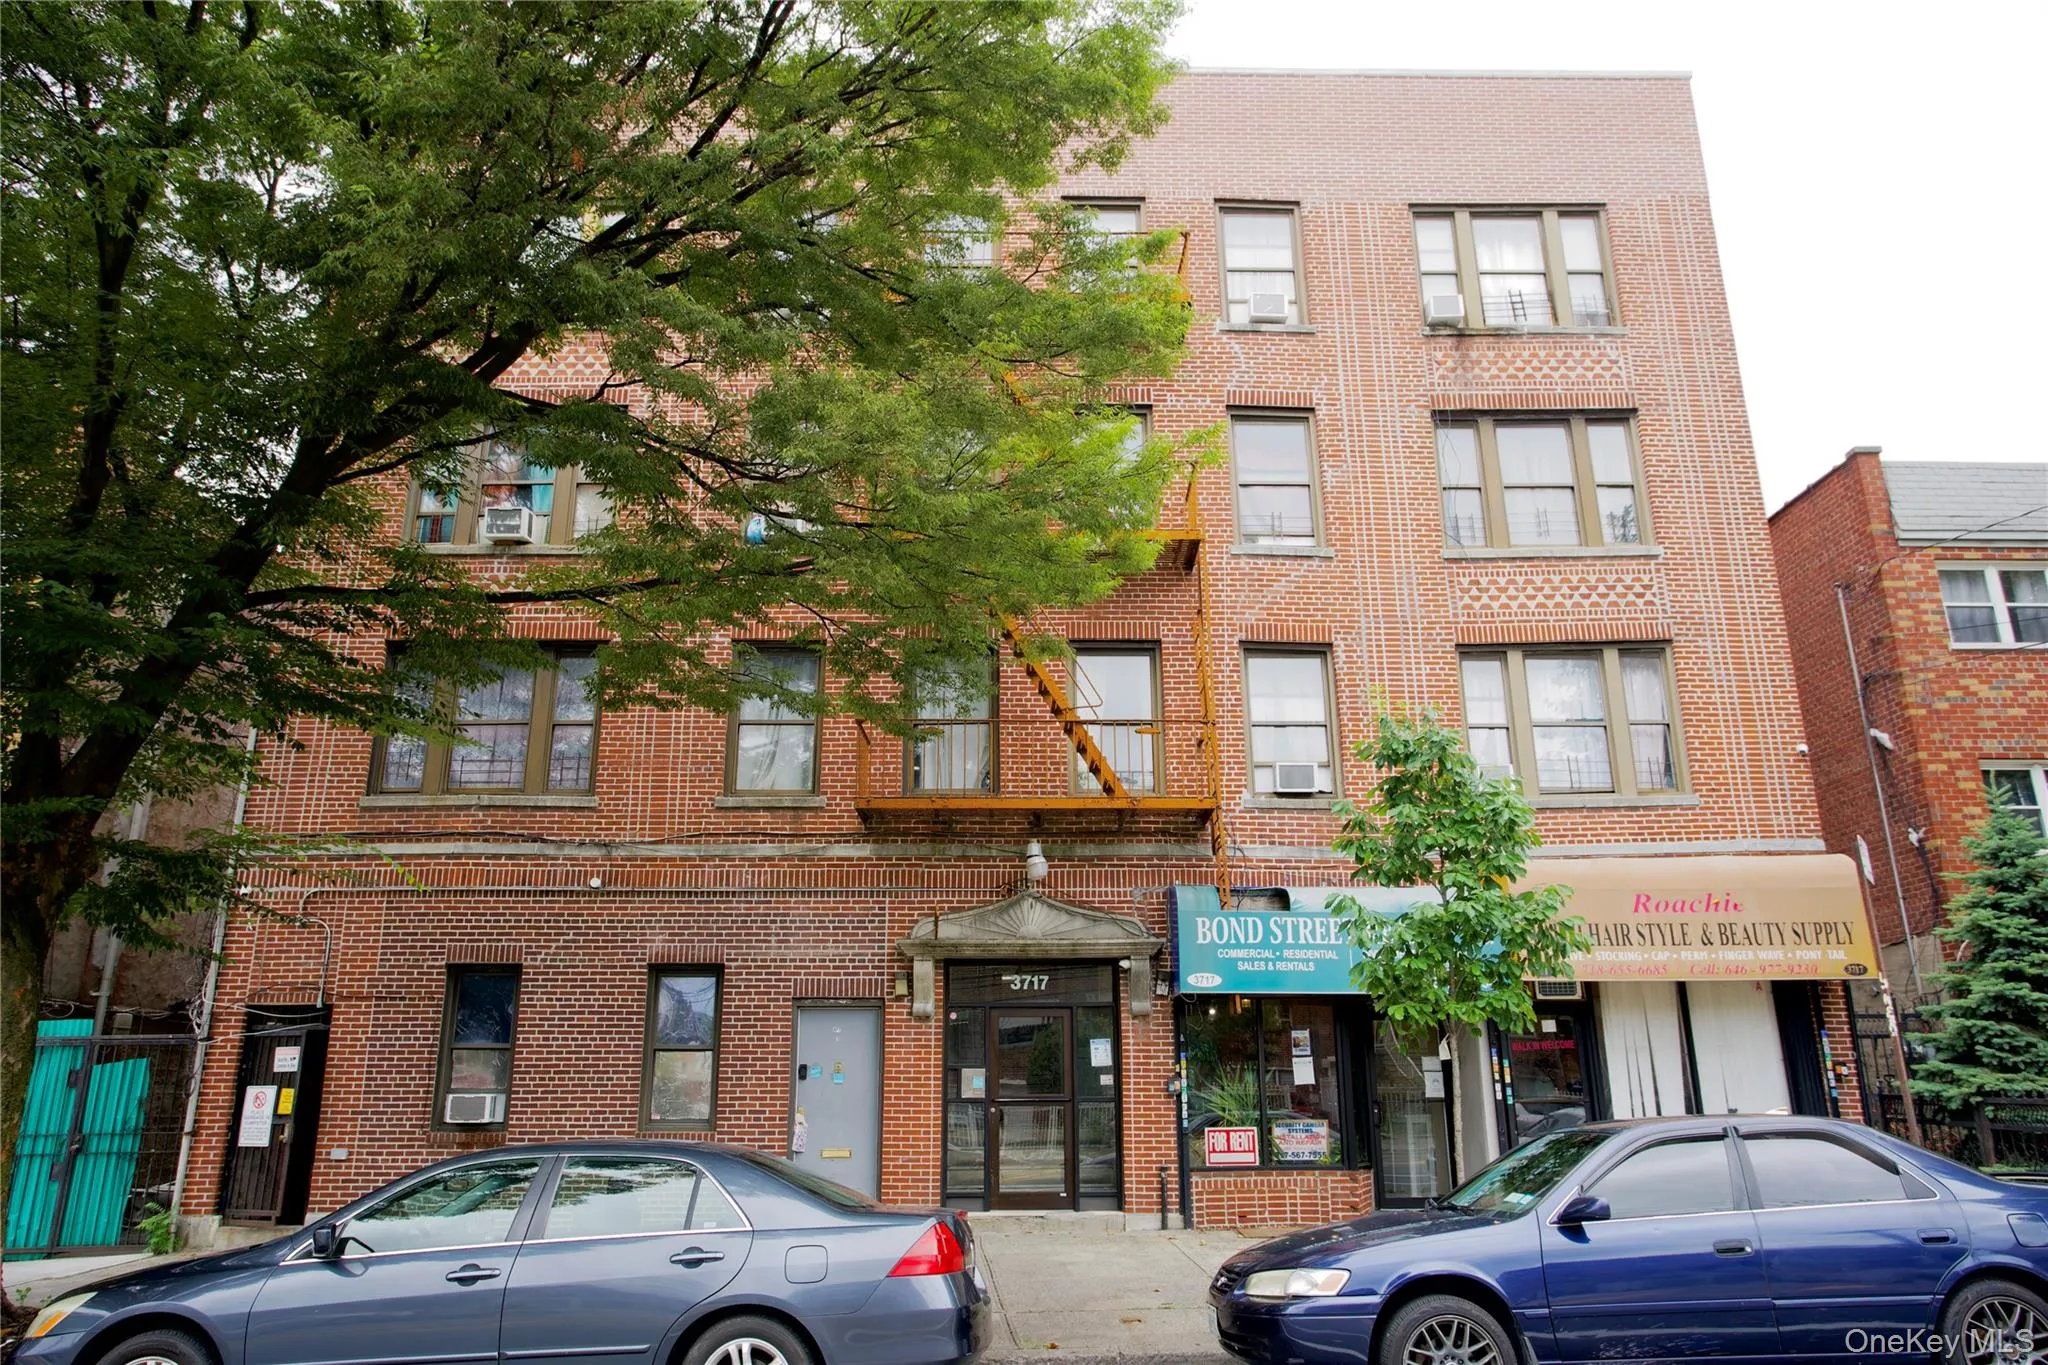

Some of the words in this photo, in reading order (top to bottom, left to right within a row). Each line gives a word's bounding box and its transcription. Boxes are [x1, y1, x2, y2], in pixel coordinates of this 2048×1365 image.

[1196, 917, 1264, 945] BOND
[1588, 922, 1634, 947] HAIR
[1637, 922, 1692, 947] STYLE
[1701, 922, 1714, 947] &
[1718, 921, 1786, 946] BEAUTY
[1791, 921, 1855, 945] SUPPLY
[1217, 949, 1275, 959] COMMERCIAL
[1283, 949, 1338, 960] RESIDENTIAL
[1596, 951, 1642, 961] STOCKING
[1651, 951, 1670, 961] CAP
[1680, 951, 1708, 961] PERM
[1719, 950, 1755, 960] FINGER
[1758, 950, 1785, 960] WAVE
[1795, 950, 1822, 960] PONY
[1828, 950, 1848, 960] TAIL
[1237, 961, 1266, 971] SALES
[1268, 962, 1274, 971] &
[1275, 962, 1315, 971] RENTALS
[1010, 975, 1049, 990] 3717
[1193, 975, 1215, 985] 3717
[1209, 1132, 1227, 1151] FOR
[1229, 1131, 1254, 1151] RENT
